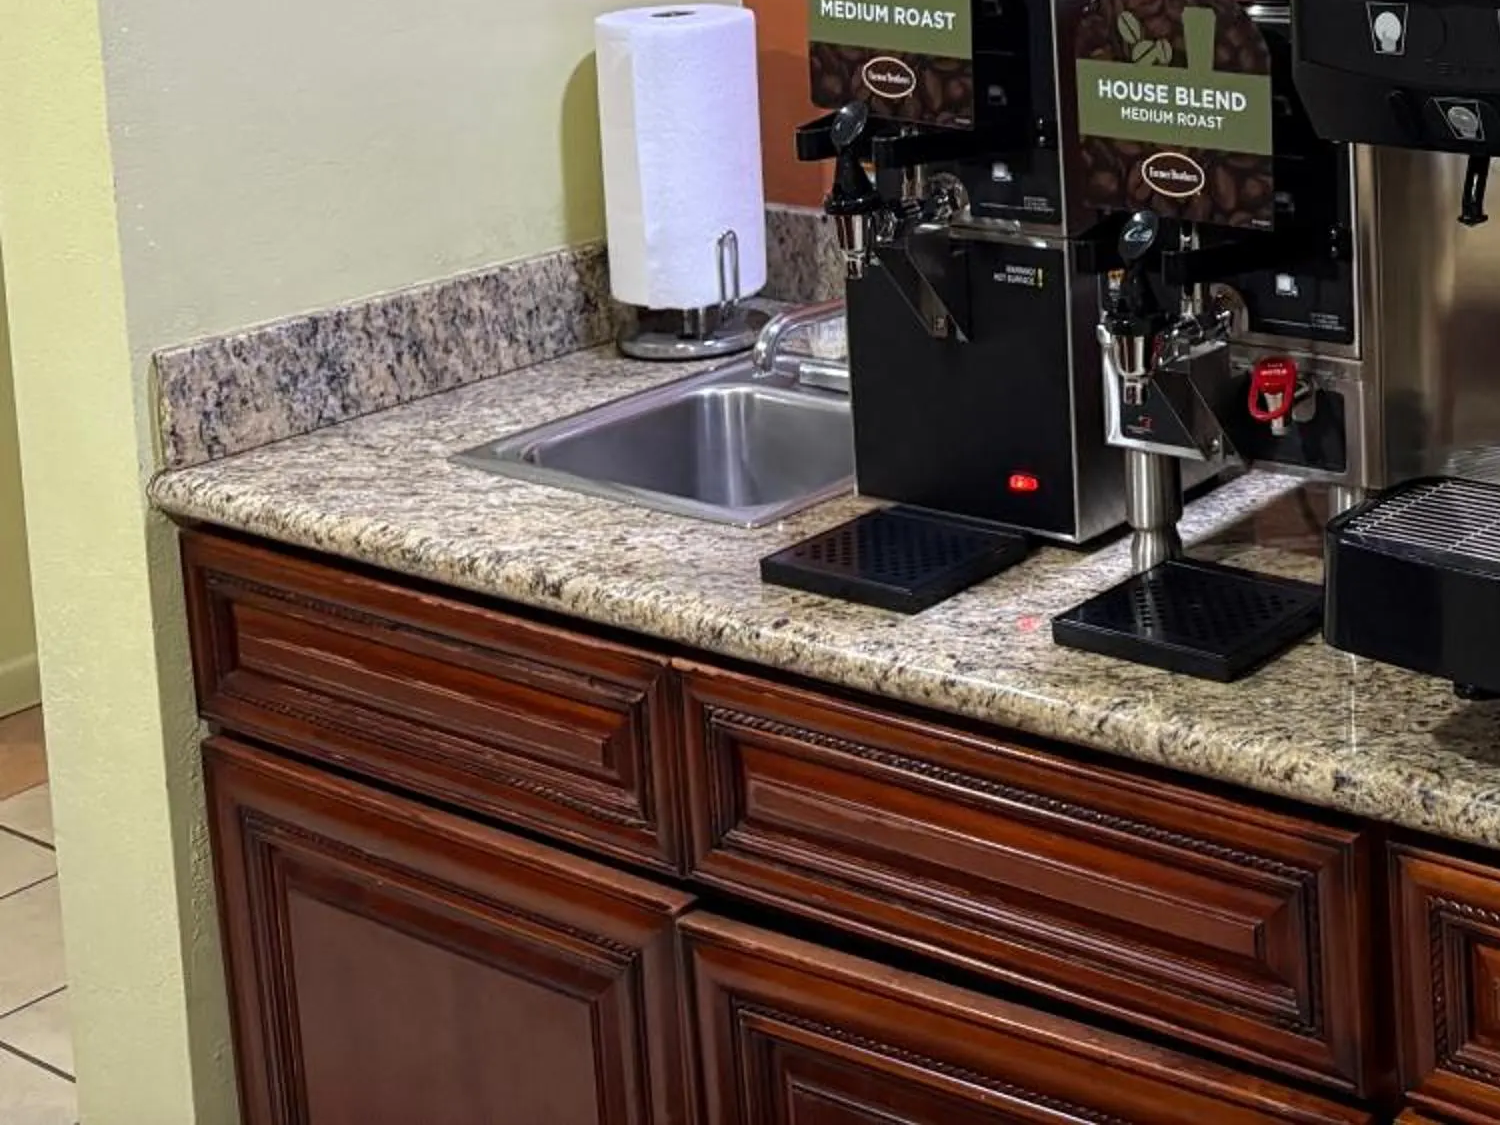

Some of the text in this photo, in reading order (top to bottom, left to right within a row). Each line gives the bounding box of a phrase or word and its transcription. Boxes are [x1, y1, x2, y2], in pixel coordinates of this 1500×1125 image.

[893, 6, 956, 30] ROAST
[1098, 79, 1247, 112] HOUSE BLEND
[1121, 106, 1224, 130] MEDIUM ROAST
